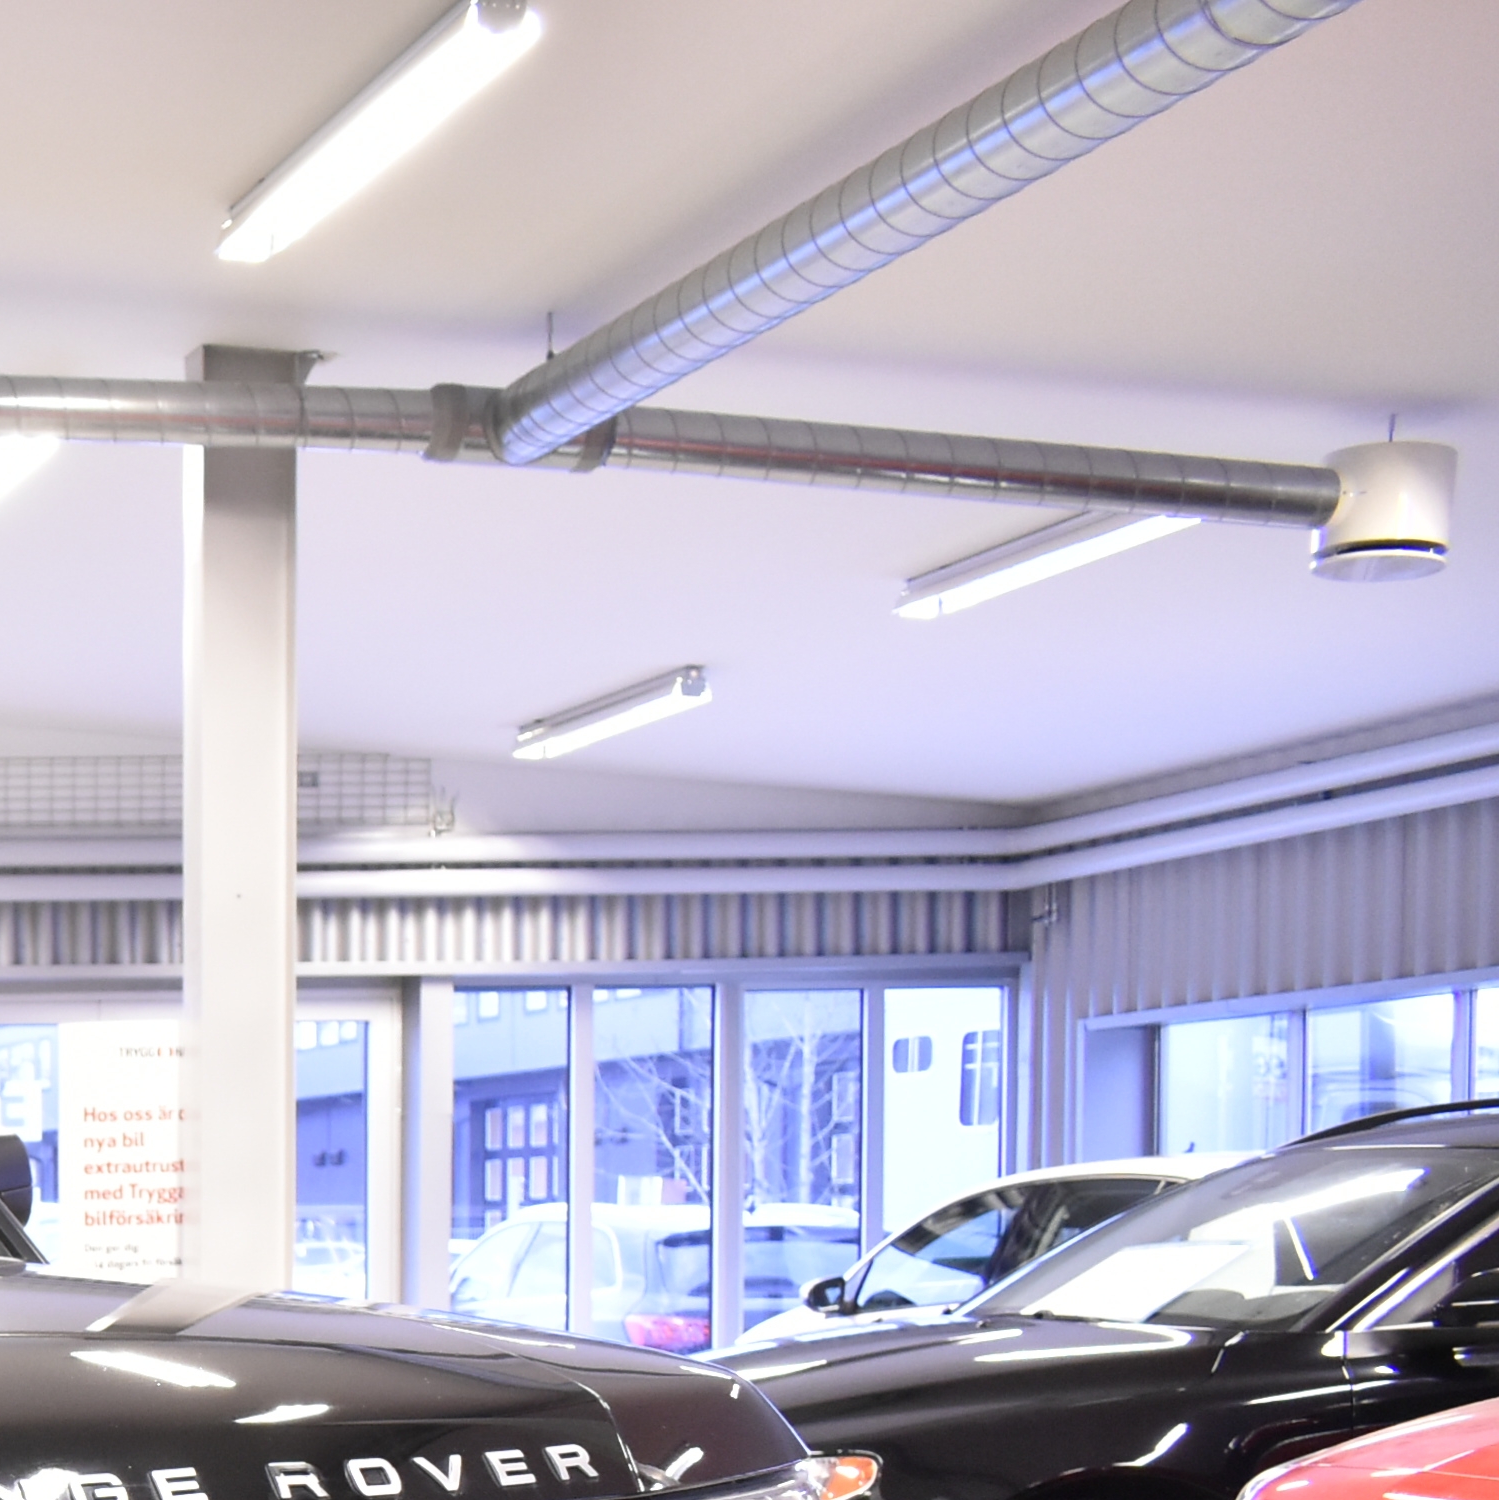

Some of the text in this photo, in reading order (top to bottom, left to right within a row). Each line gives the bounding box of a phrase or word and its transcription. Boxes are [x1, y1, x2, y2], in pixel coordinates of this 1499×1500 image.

[83, 1106, 118, 1122] Hos
[123, 1109, 153, 1122] oss
[158, 1105, 175, 1121] är
[83, 1132, 145, 1153] nya bil
[84, 1184, 123, 1200] med
[264, 1443, 600, 1500] ROVER
